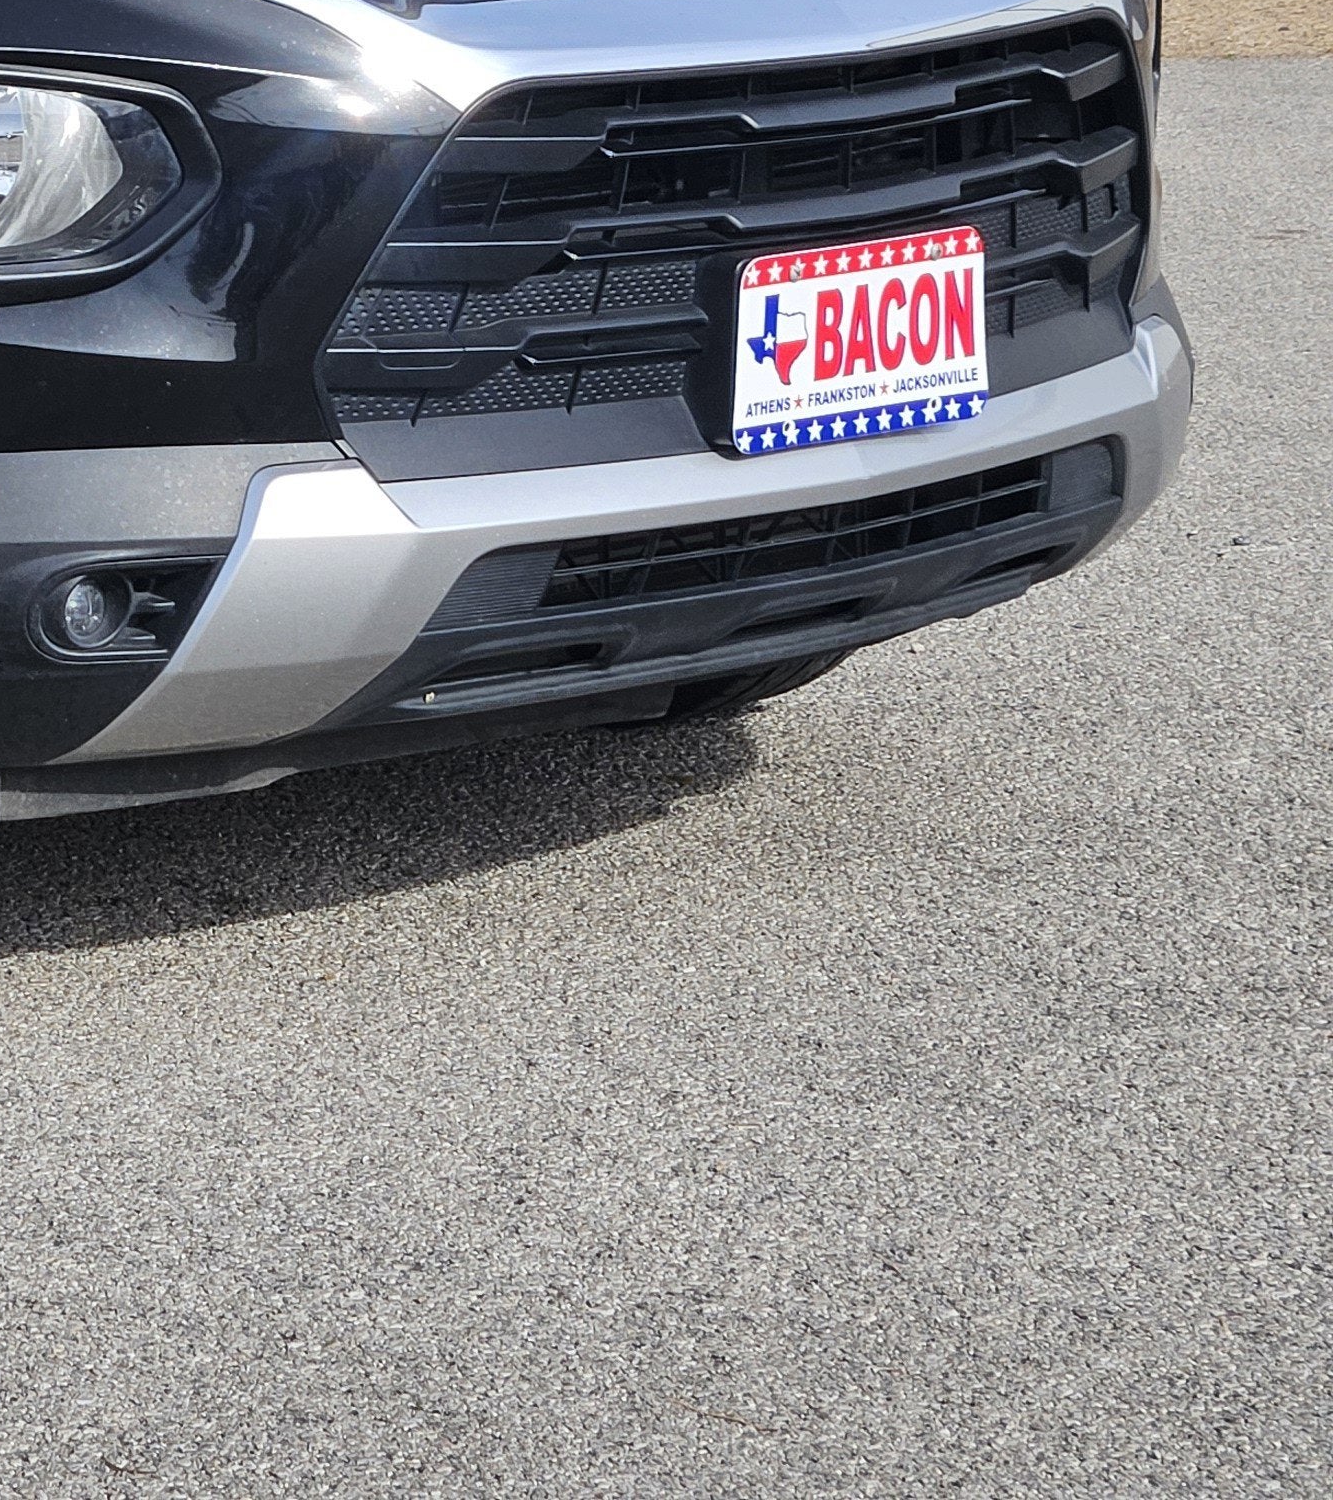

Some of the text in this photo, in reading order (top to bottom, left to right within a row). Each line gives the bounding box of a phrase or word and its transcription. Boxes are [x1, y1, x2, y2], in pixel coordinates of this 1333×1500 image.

[814, 267, 975, 381] BACON
[745, 367, 979, 418] ATHENS FRANKSTON JACKSONVILLE
